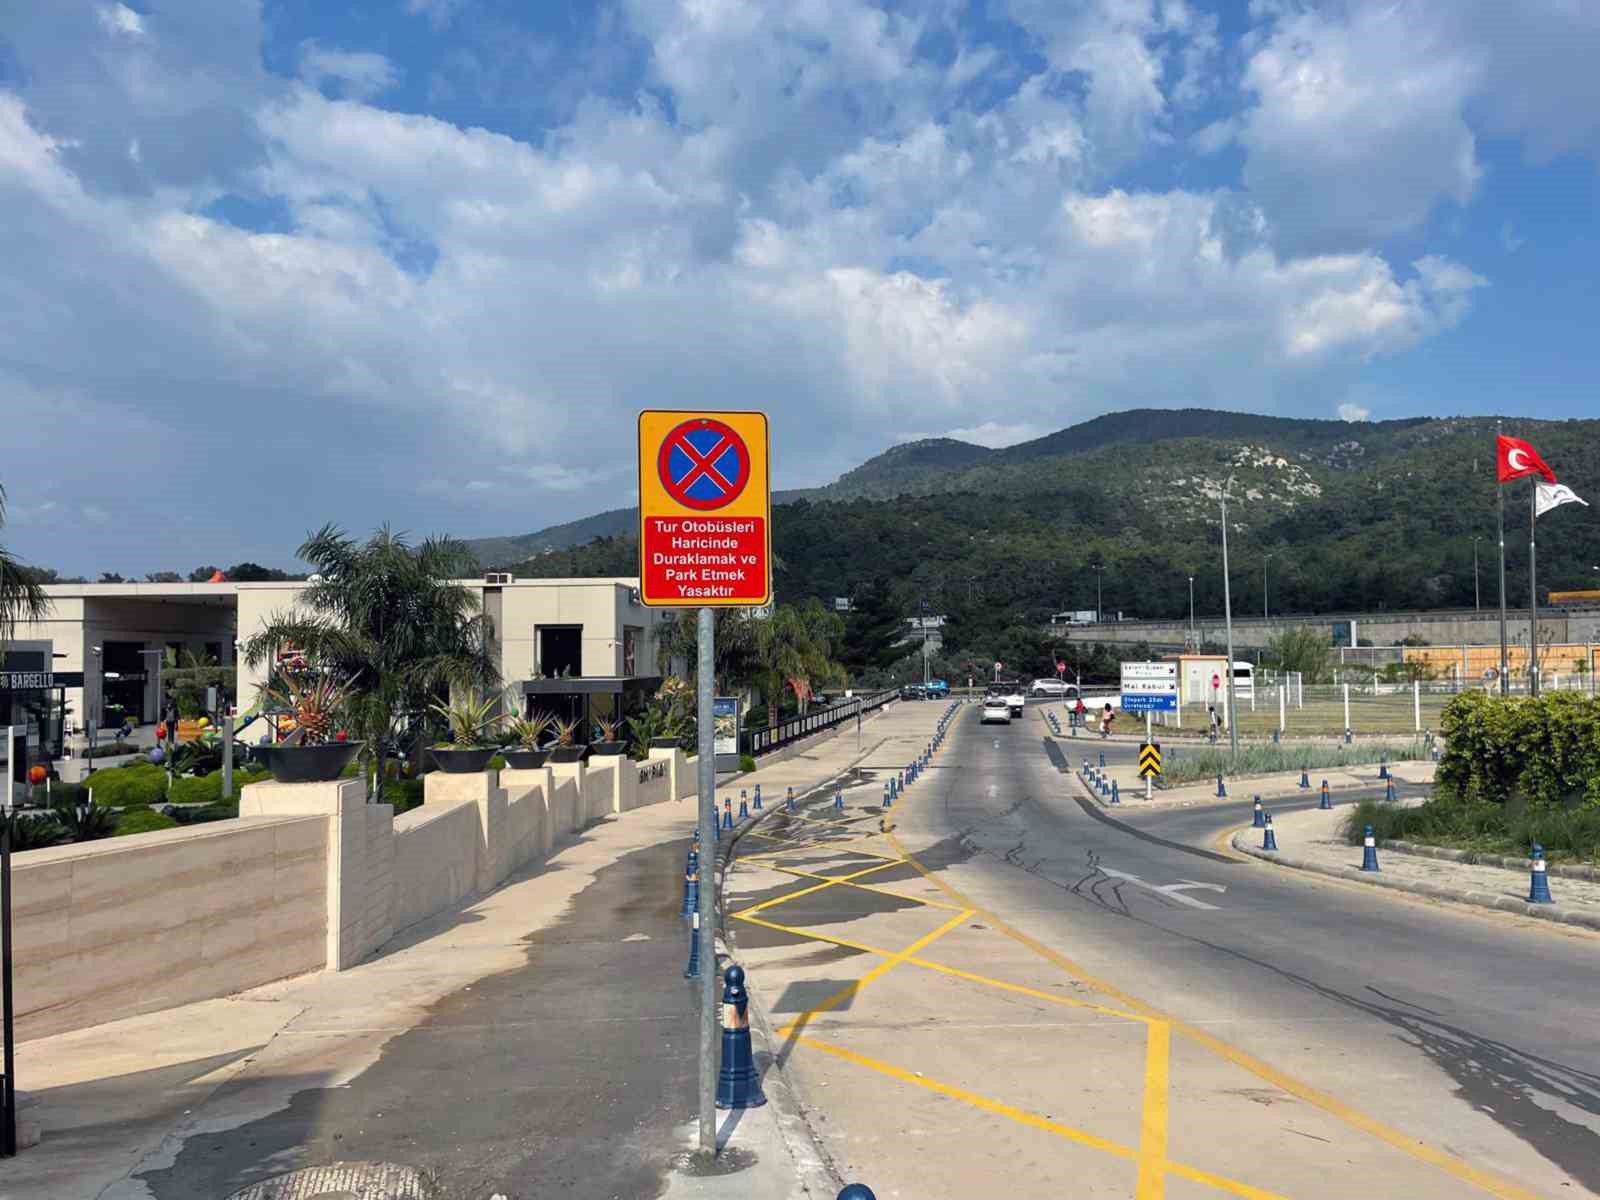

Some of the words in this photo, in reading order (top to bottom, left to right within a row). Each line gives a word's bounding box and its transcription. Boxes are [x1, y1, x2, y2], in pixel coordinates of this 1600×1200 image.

[655, 521, 678, 533] Tur
[681, 520, 755, 533] Otobüsleri
[671, 537, 738, 549] Haricinde
[653, 553, 737, 565] Duraklamak
[741, 555, 757, 565] ve
[666, 569, 697, 581] Park
[702, 569, 745, 581] Etmek
[678, 585, 734, 597] Yasaktır
[11, 673, 54, 689] BARGELLO
